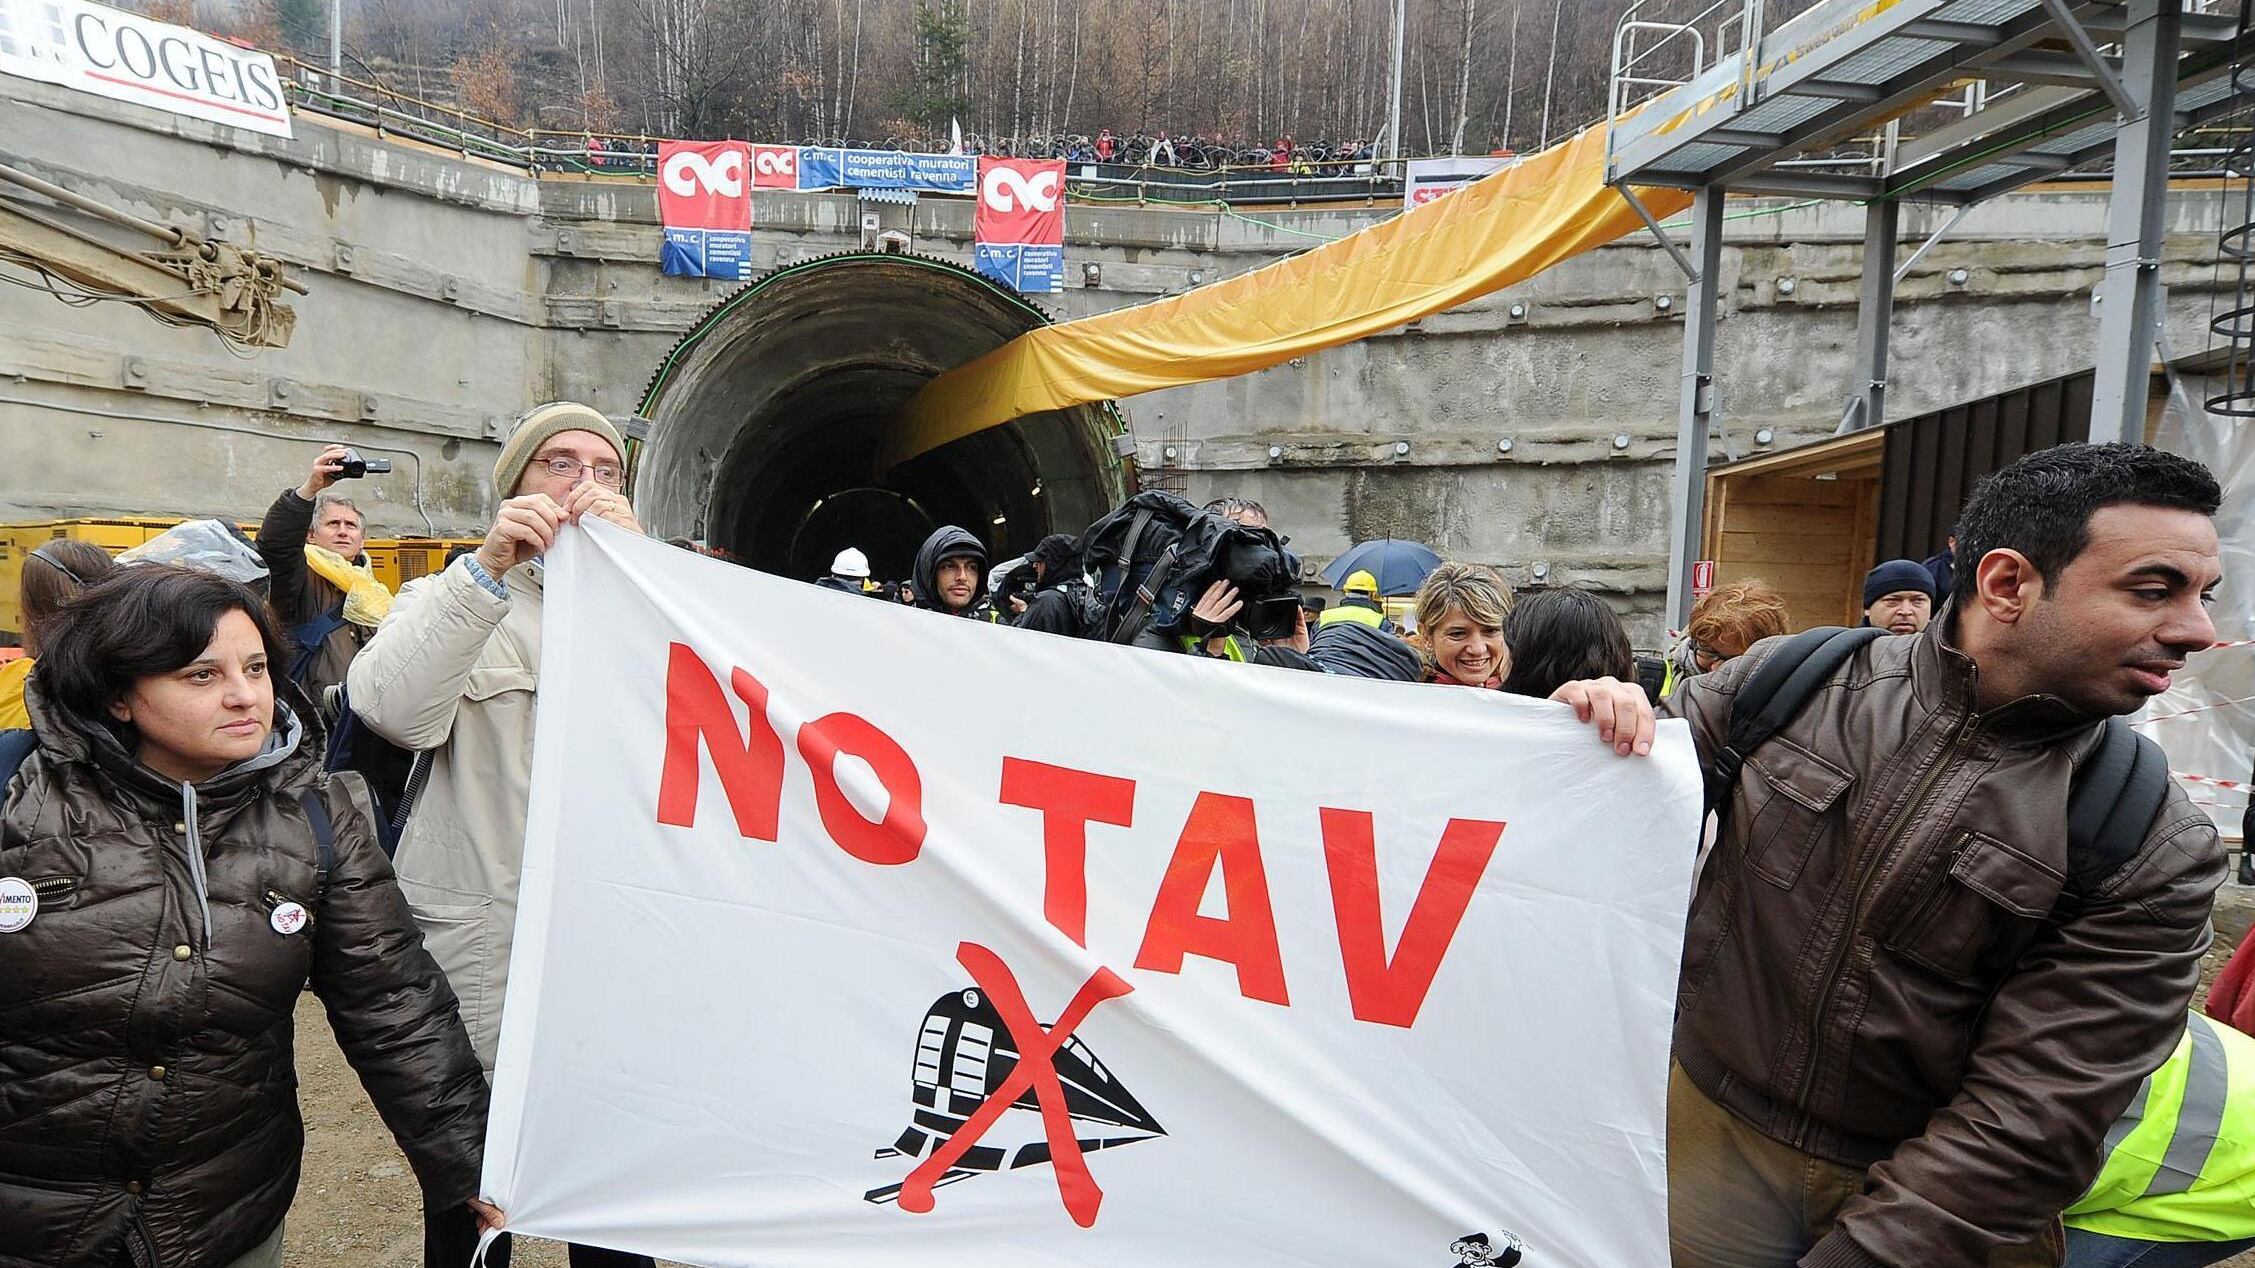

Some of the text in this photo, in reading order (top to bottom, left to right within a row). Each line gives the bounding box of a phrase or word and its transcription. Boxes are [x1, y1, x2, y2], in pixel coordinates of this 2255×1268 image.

[75, 13, 279, 111] COGEIS
[847, 154, 969, 170] cooperativa muratori
[847, 166, 957, 182] cementisti ravenna
[656, 641, 1507, 1028] NO TAV
